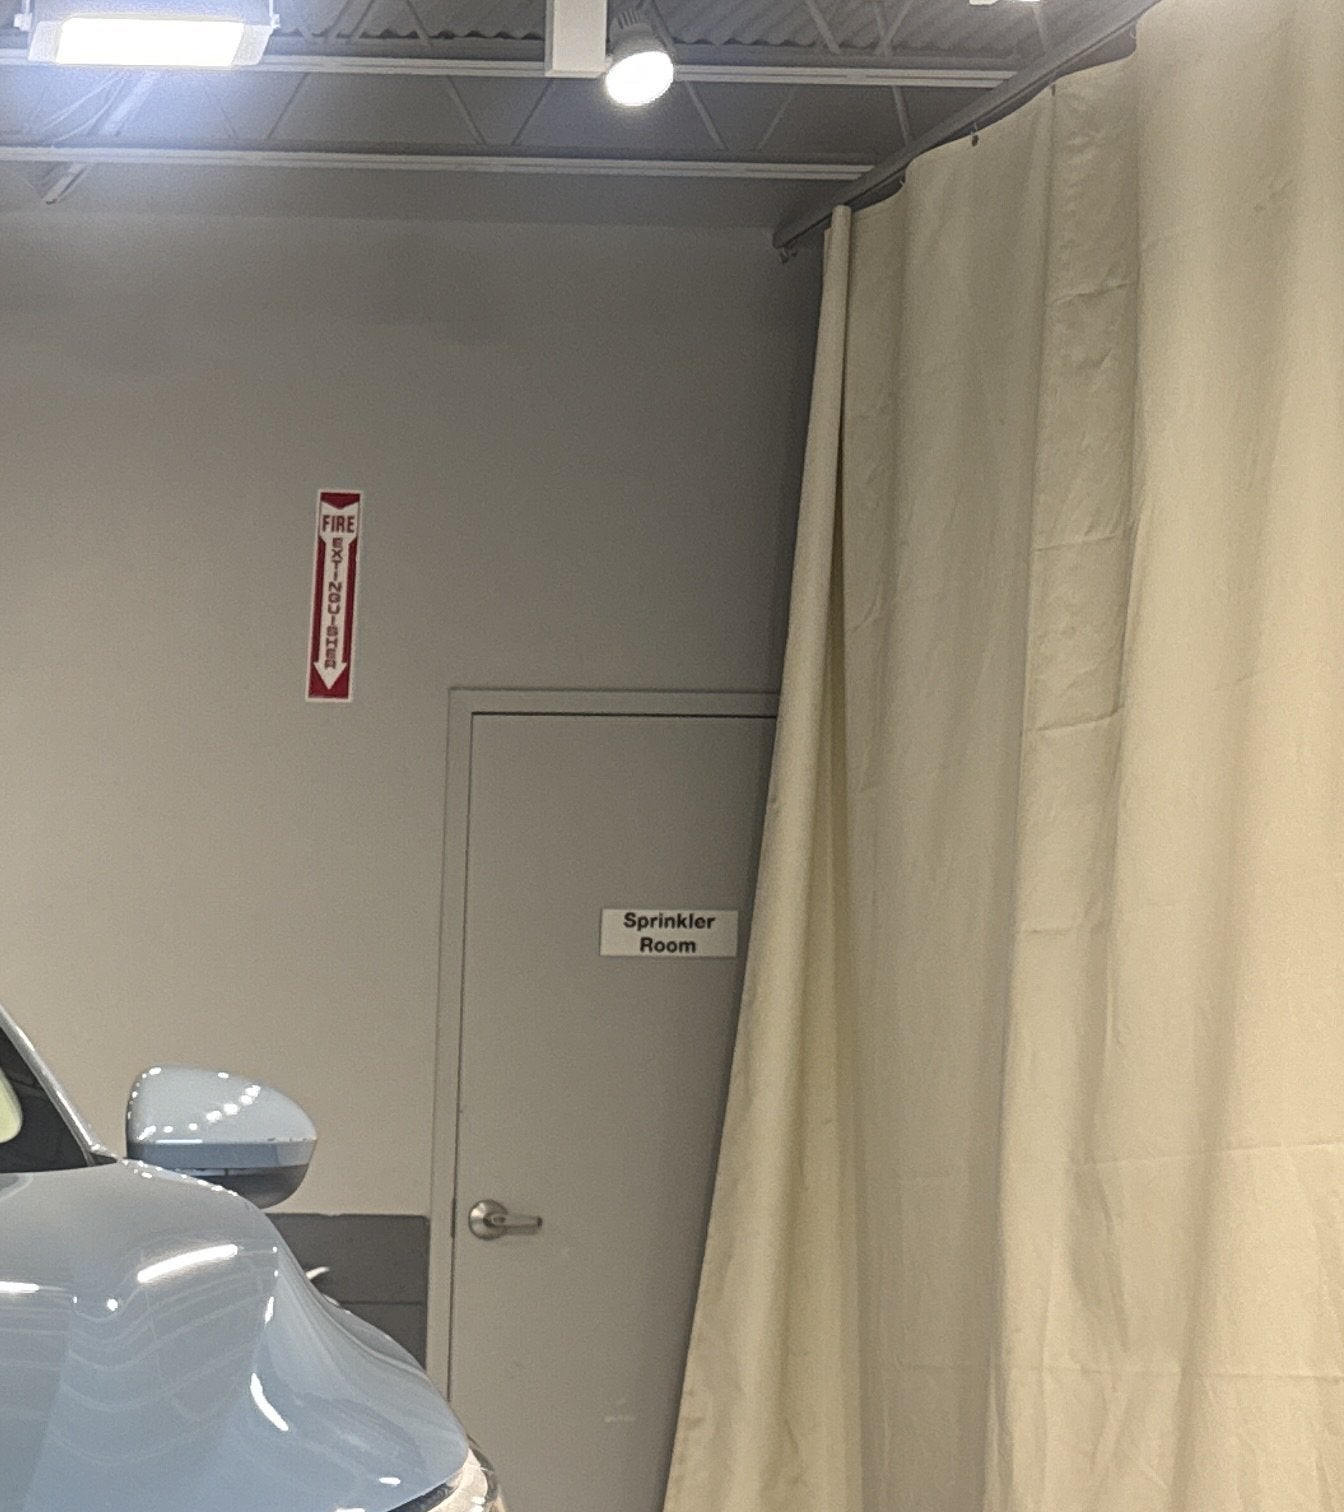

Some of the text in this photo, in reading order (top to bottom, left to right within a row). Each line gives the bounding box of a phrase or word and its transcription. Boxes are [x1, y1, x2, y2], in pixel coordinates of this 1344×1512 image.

[322, 515, 355, 533] FIRE
[324, 537, 344, 670] EXTINGUISHER
[623, 912, 715, 931] Sprinkler
[640, 937, 696, 953] Room
